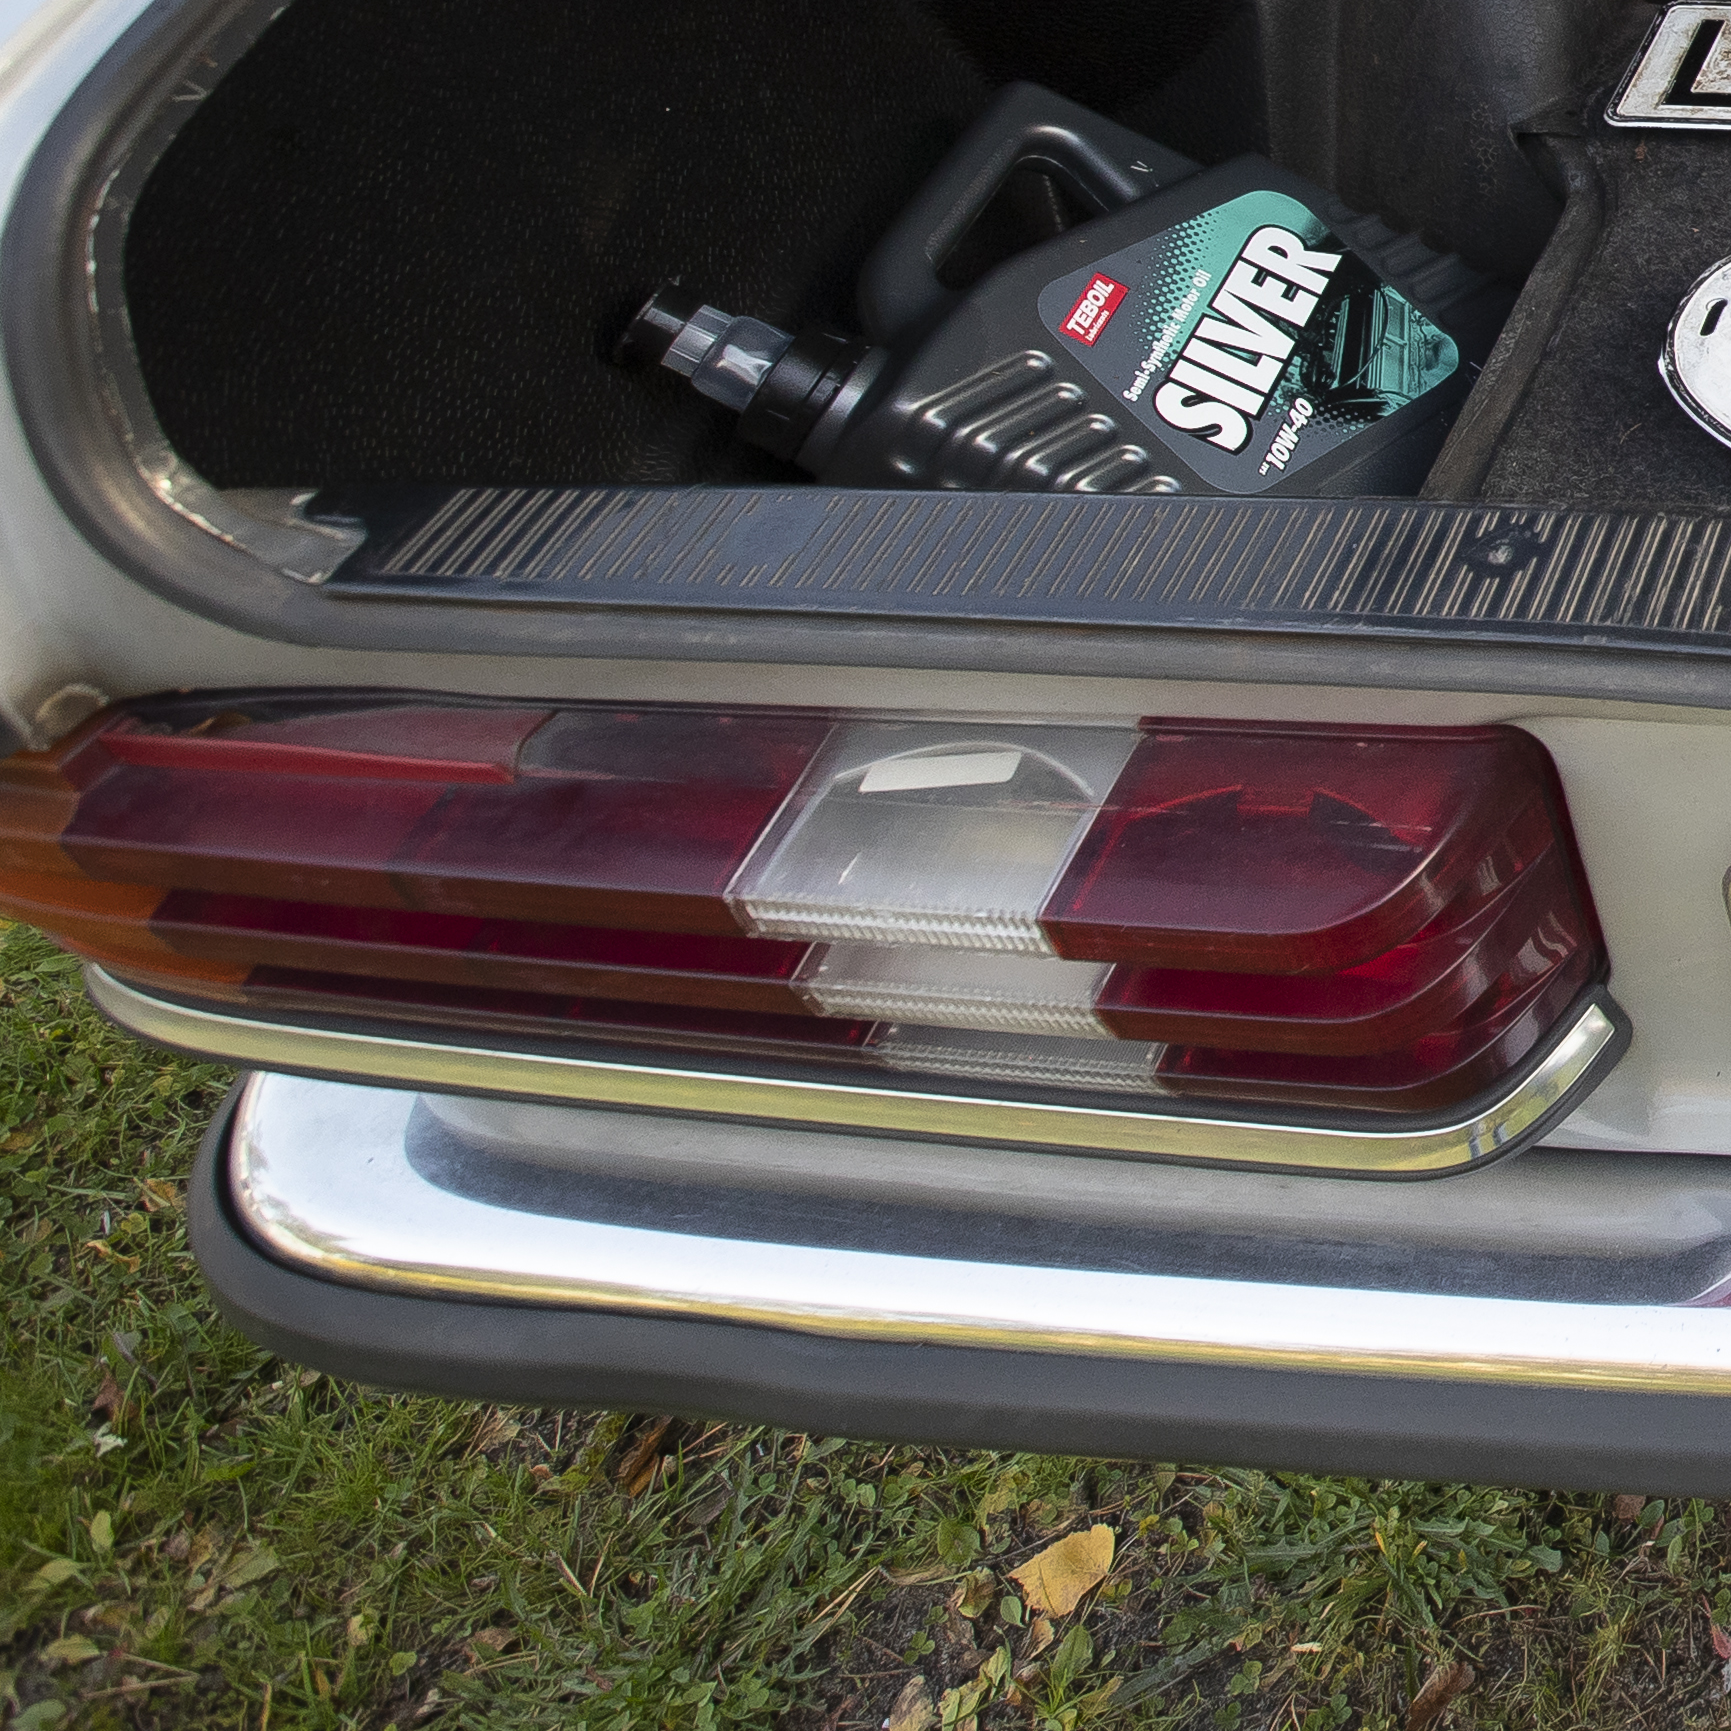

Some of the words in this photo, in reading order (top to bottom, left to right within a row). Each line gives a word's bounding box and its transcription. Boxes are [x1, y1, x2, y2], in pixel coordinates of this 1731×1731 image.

[1067, 277, 1114, 334] TEBOIL
[1123, 321, 1179, 402] Semi-Synthetic
[1173, 289, 1200, 327] Motor
[1192, 269, 1212, 289] Oil
[1155, 225, 1343, 453] SILVER
[1265, 397, 1313, 470] 10W-40
